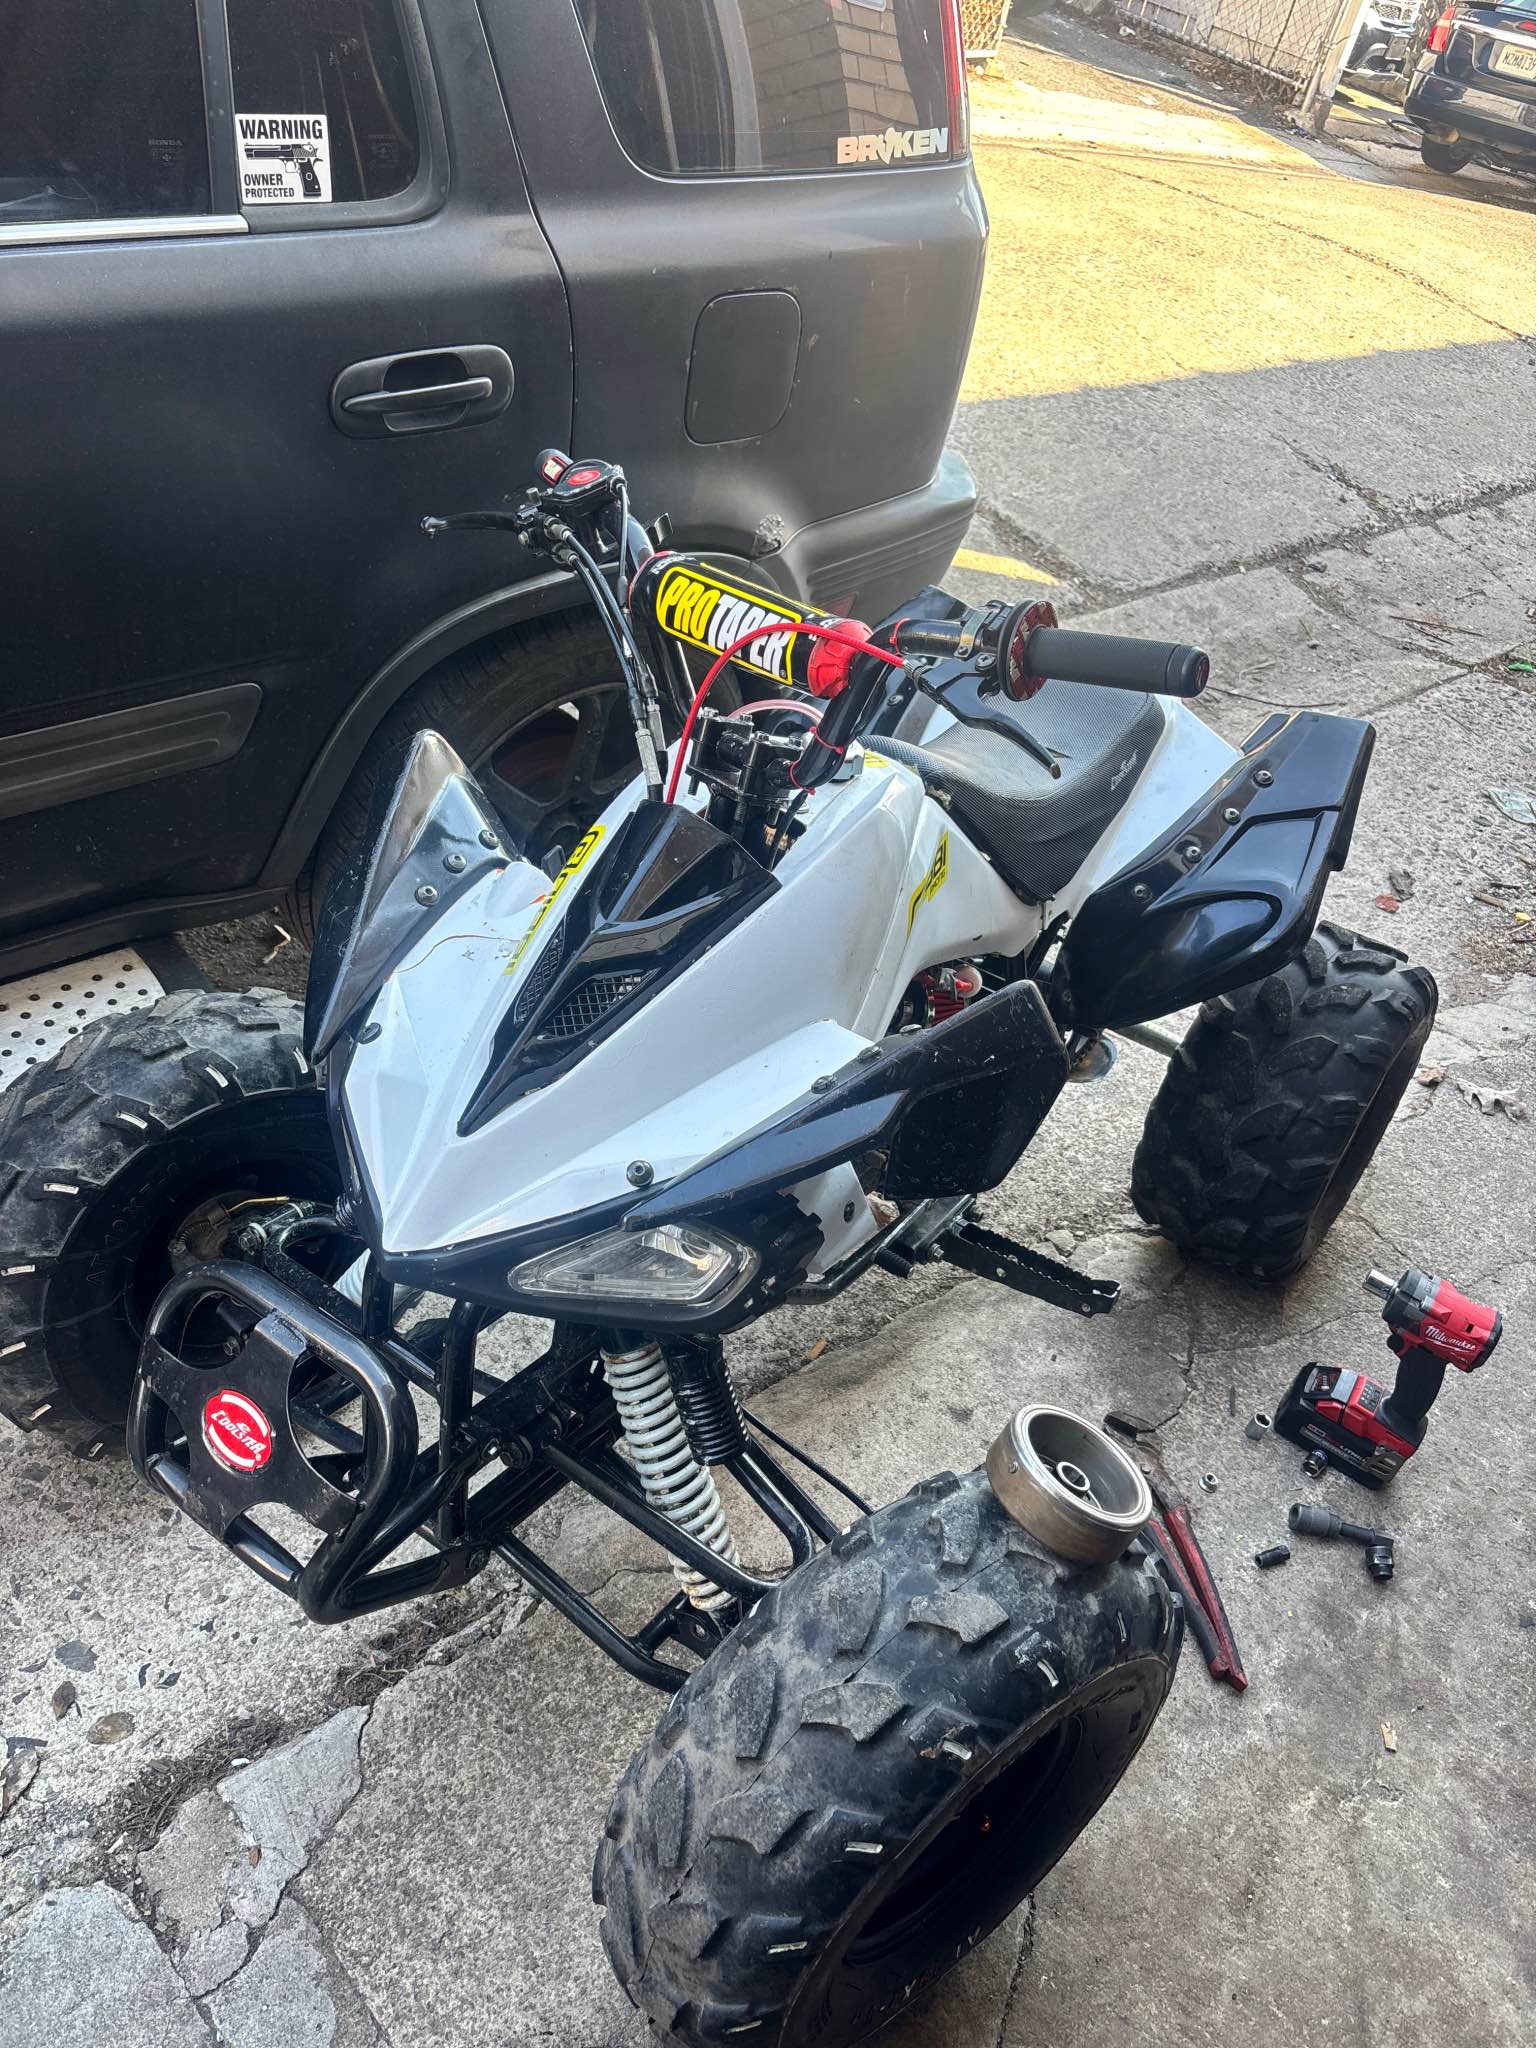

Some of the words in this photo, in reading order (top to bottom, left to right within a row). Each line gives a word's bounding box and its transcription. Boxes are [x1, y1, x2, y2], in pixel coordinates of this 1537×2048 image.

[238, 119, 323, 139] WARNING
[244, 173, 283, 186] OWNER
[244, 187, 295, 198] PROTECTED
[1425, 1325, 1477, 1351] Milwaukee
